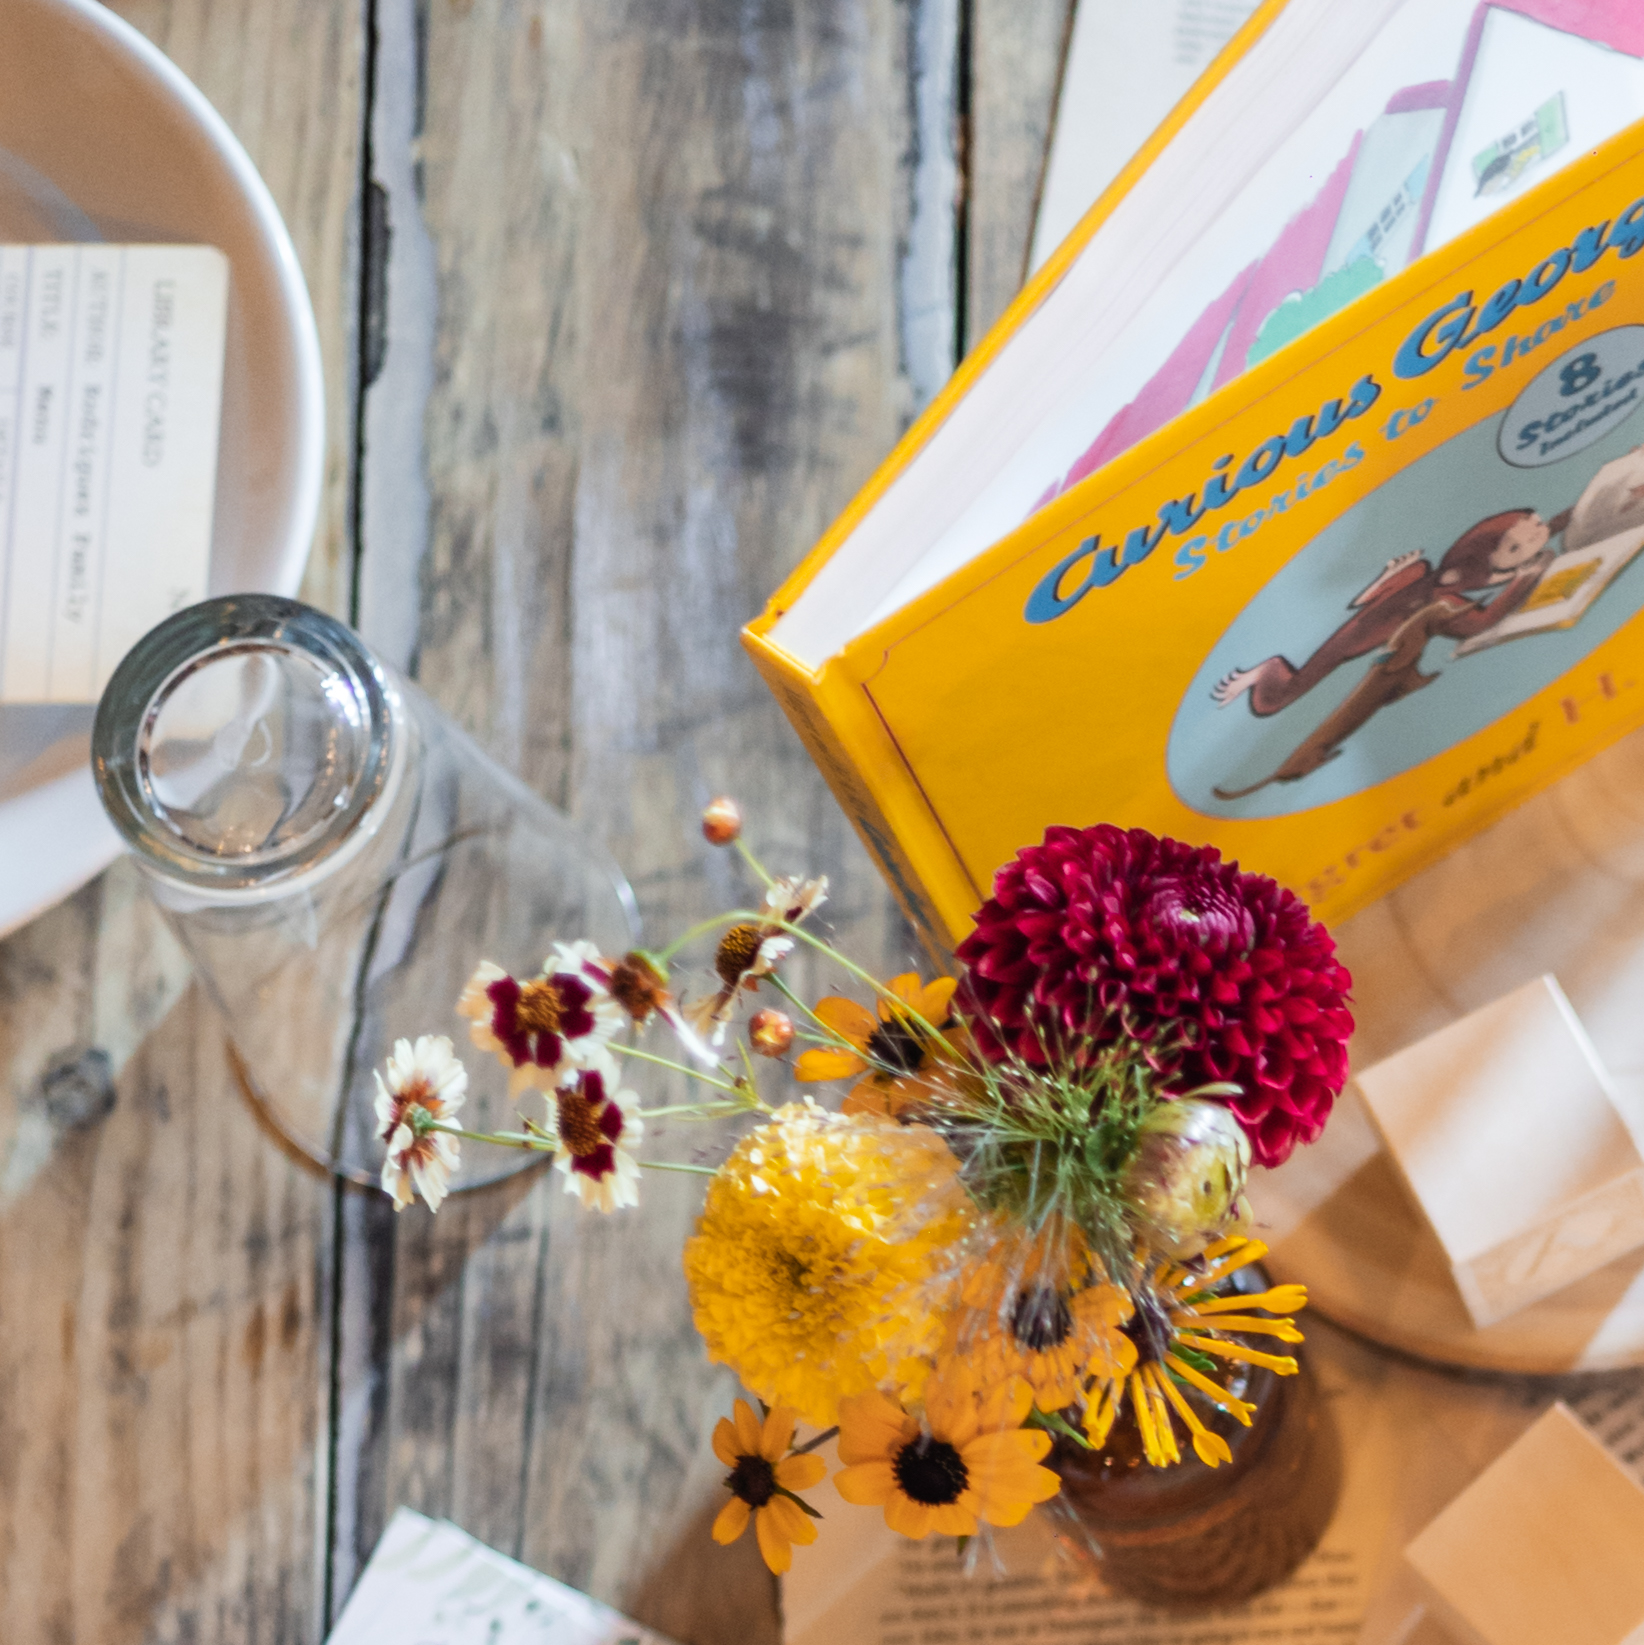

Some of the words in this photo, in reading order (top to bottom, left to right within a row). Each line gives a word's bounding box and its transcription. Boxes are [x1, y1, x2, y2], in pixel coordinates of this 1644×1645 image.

[145, 277, 177, 388] LIBRARY
[1557, 351, 1603, 398] 8
[140, 389, 167, 468] CARD
[1173, 441, 1365, 581] Stories
[1384, 397, 1435, 441] to
[1460, 279, 1615, 391] Share
[1024, 373, 1384, 625] Curious
